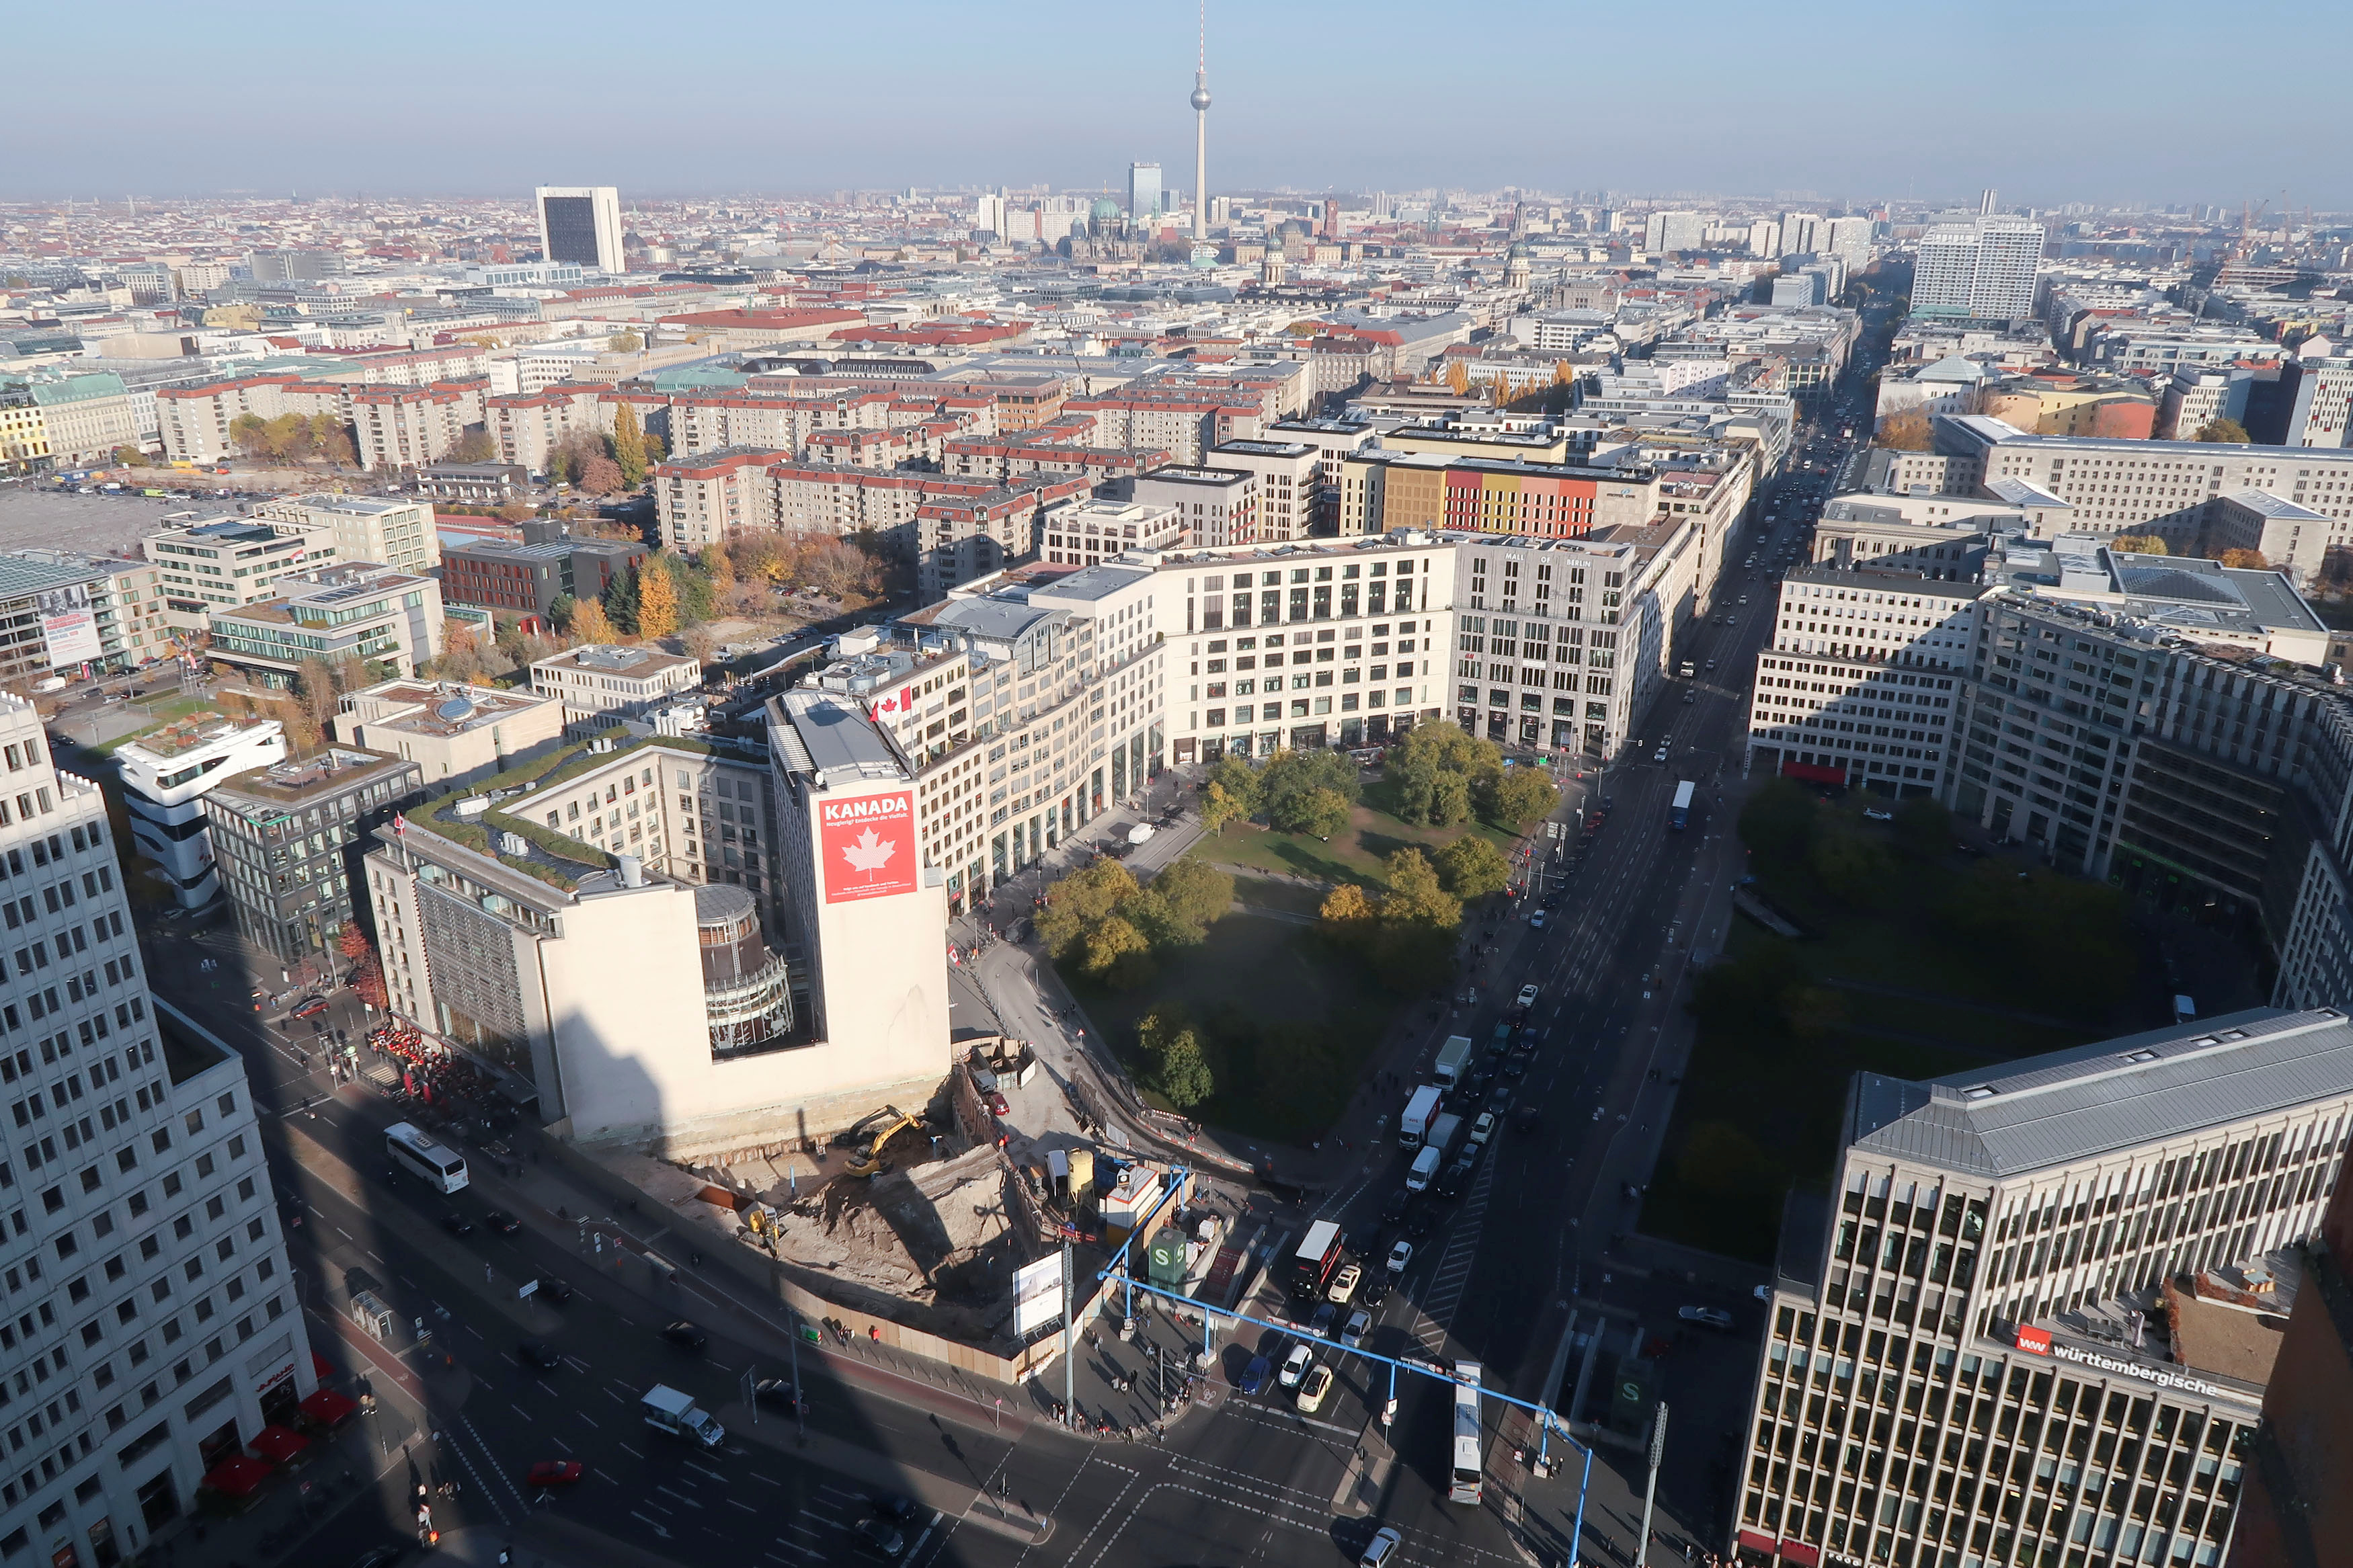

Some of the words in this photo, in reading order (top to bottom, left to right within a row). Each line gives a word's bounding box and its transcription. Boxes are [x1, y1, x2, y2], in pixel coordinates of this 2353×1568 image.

[1505, 552, 1524, 561] MALL
[1566, 559, 1591, 567] BERLIN
[825, 796, 909, 821] KANADA
[826, 819, 854, 827] Neugierig?
[854, 816, 879, 824] Entdecke
[1155, 1249, 1169, 1266] S
[1177, 1243, 1184, 1264] S
[2053, 1345, 2217, 1396] württembergische
[1622, 1382, 1639, 1401] S
[1828, 1552, 1862, 1567] FOOD
